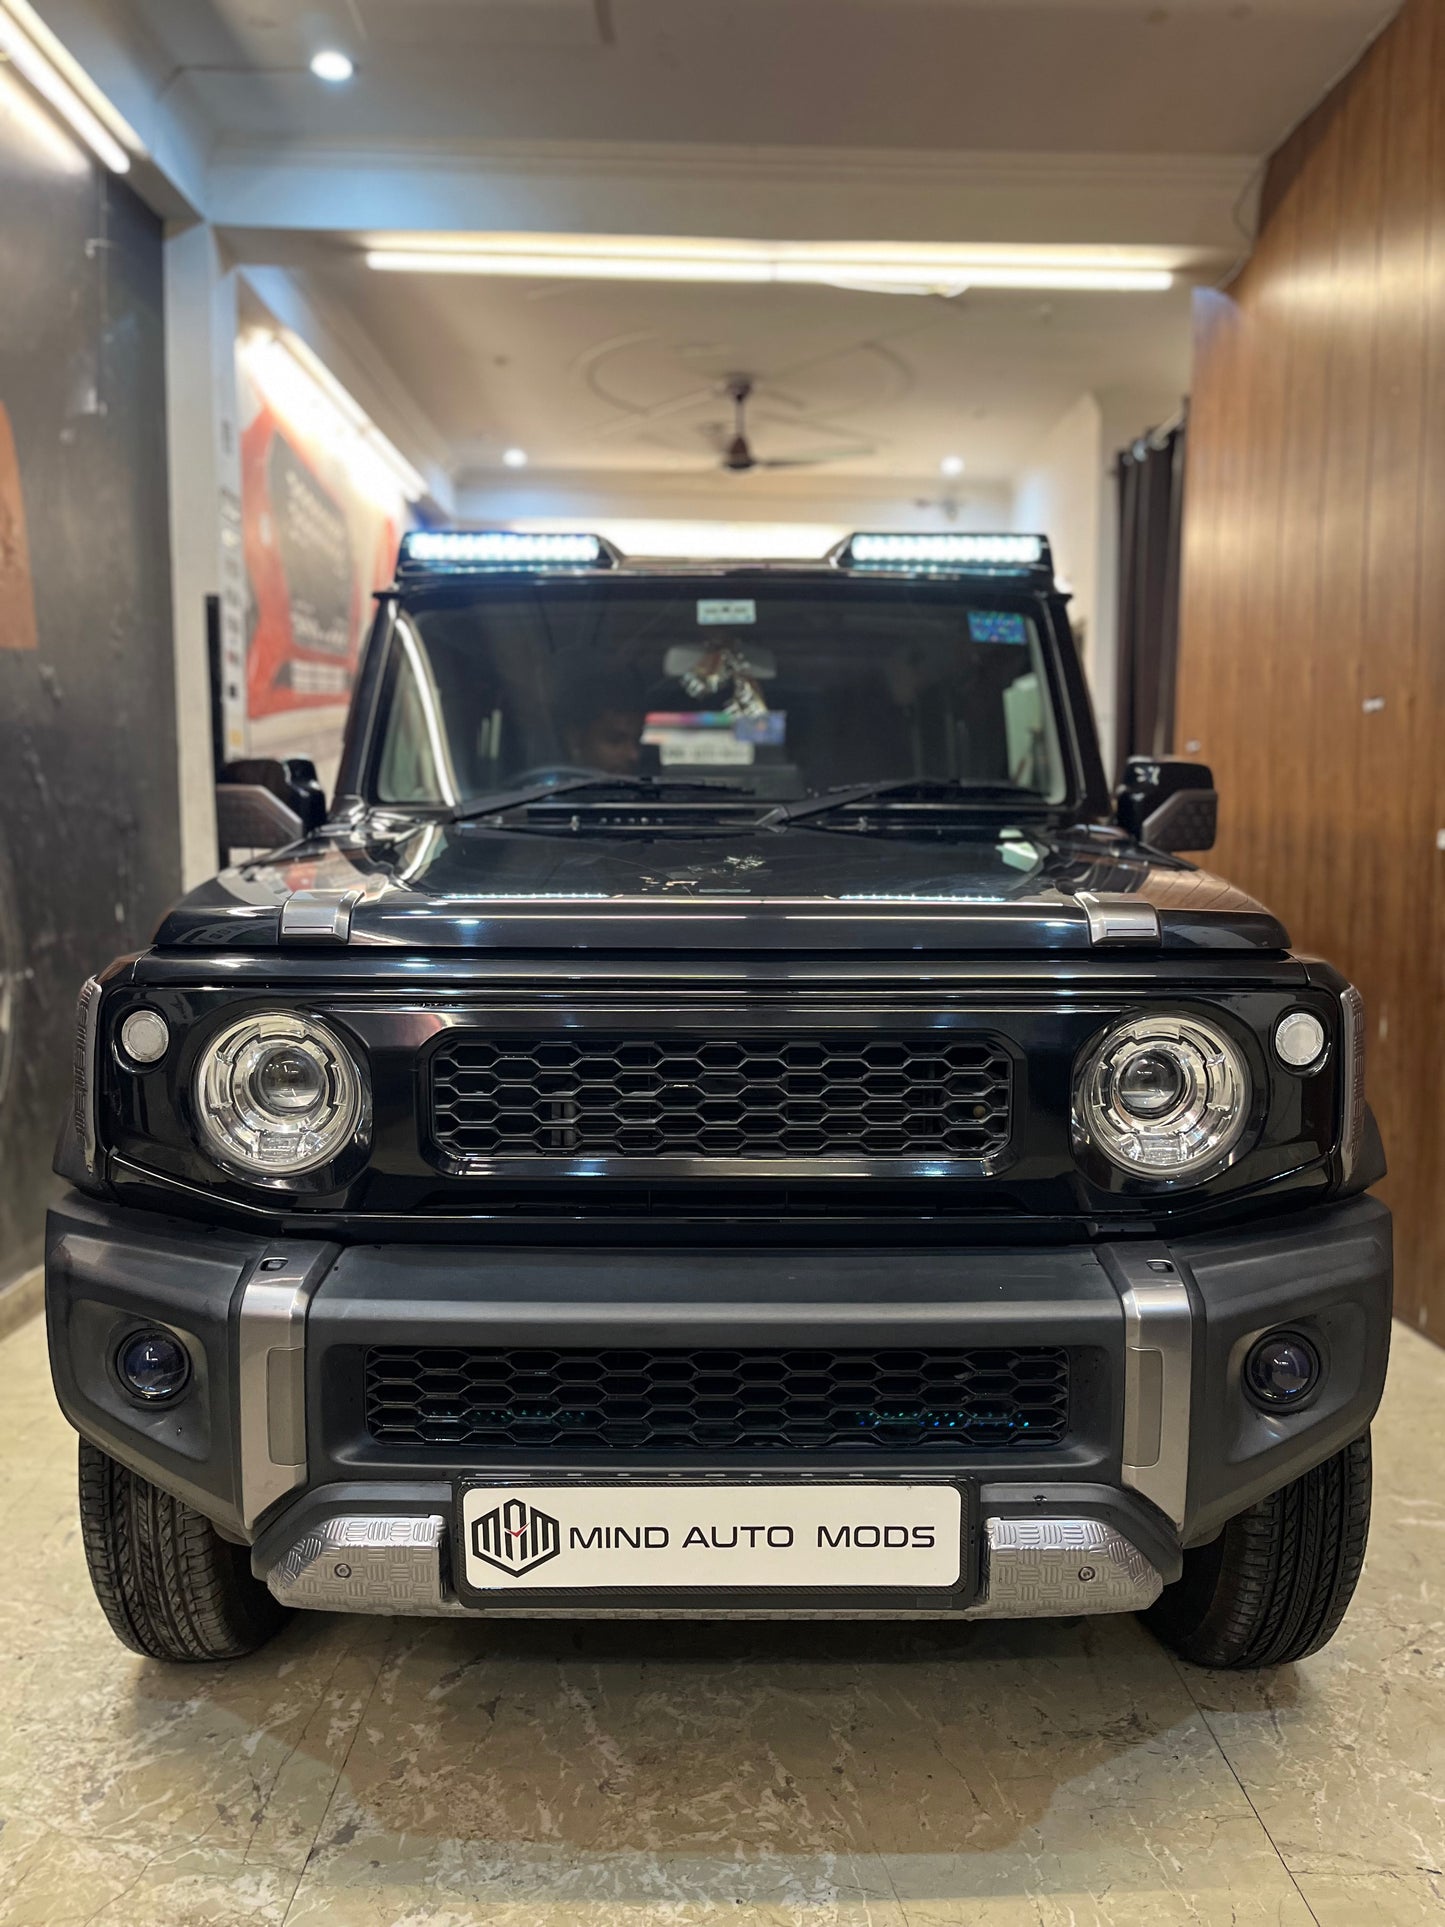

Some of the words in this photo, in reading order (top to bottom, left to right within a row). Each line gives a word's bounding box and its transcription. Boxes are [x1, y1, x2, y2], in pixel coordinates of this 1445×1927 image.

[569, 1526, 670, 1549] MIND
[681, 1525, 794, 1548] AUTO
[816, 1525, 935, 1548] MODS
